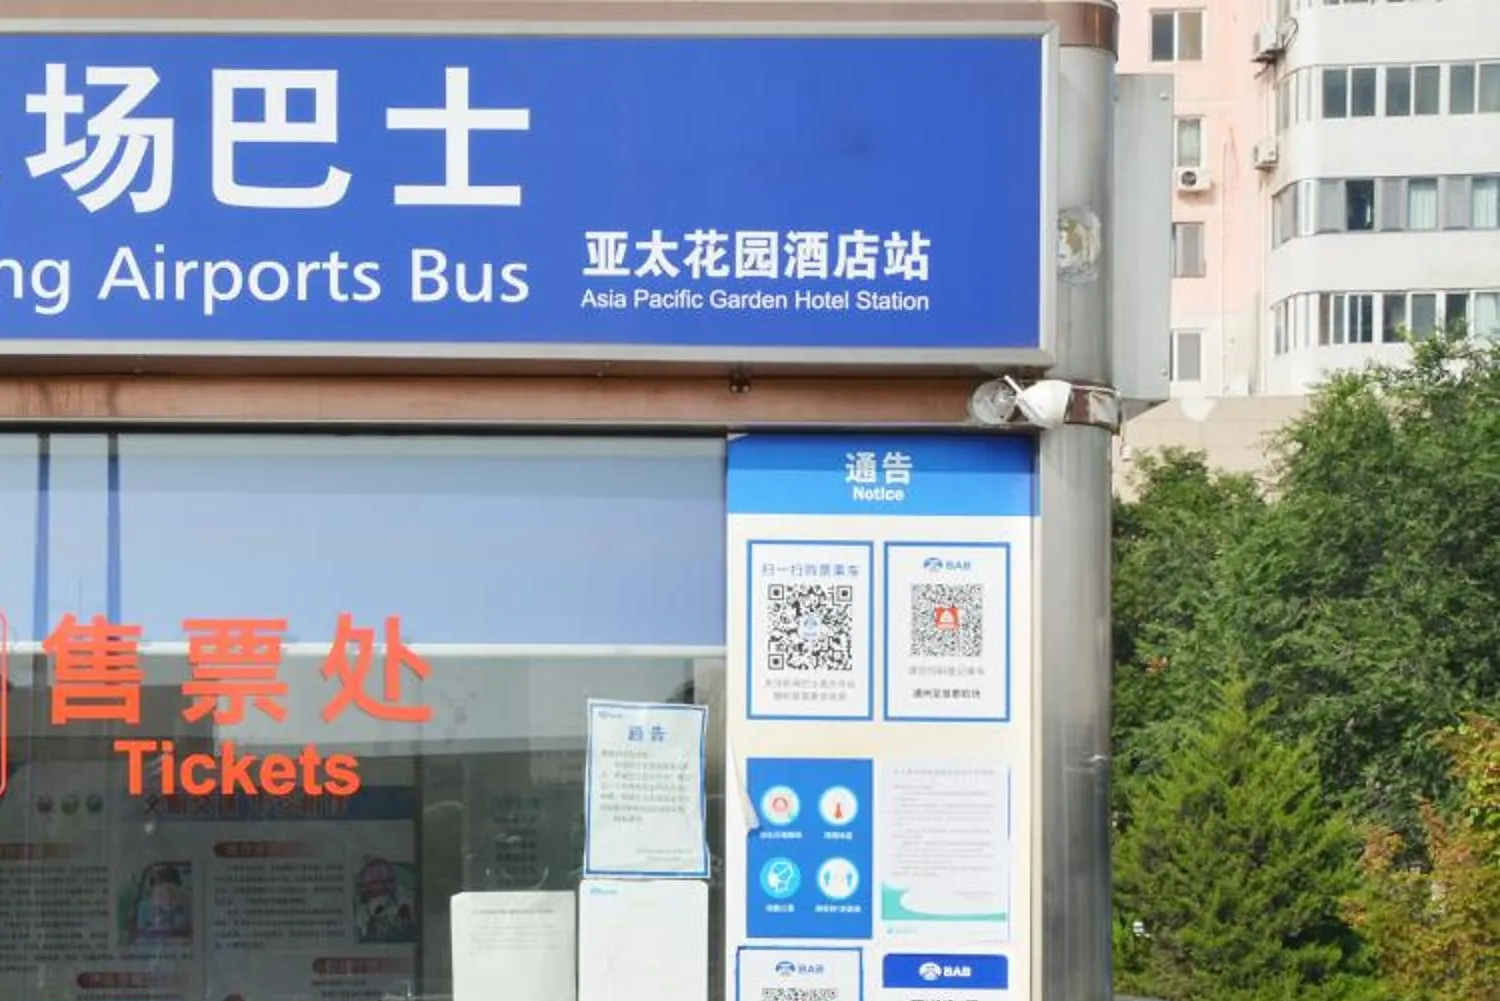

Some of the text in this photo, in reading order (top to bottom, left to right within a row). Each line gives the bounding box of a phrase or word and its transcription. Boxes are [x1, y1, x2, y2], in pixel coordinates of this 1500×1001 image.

[583, 229, 930, 280] 亚太花园酒店站
[98, 244, 380, 315] Airports
[412, 249, 529, 302] Bus
[580, 289, 929, 310] Asia Pacific Garden Hotel Station
[846, 452, 913, 484] 通告
[853, 487, 905, 501] Notice
[43, 613, 432, 725] 售票处
[115, 739, 360, 797] Tickets
[943, 966, 971, 977] BAB
